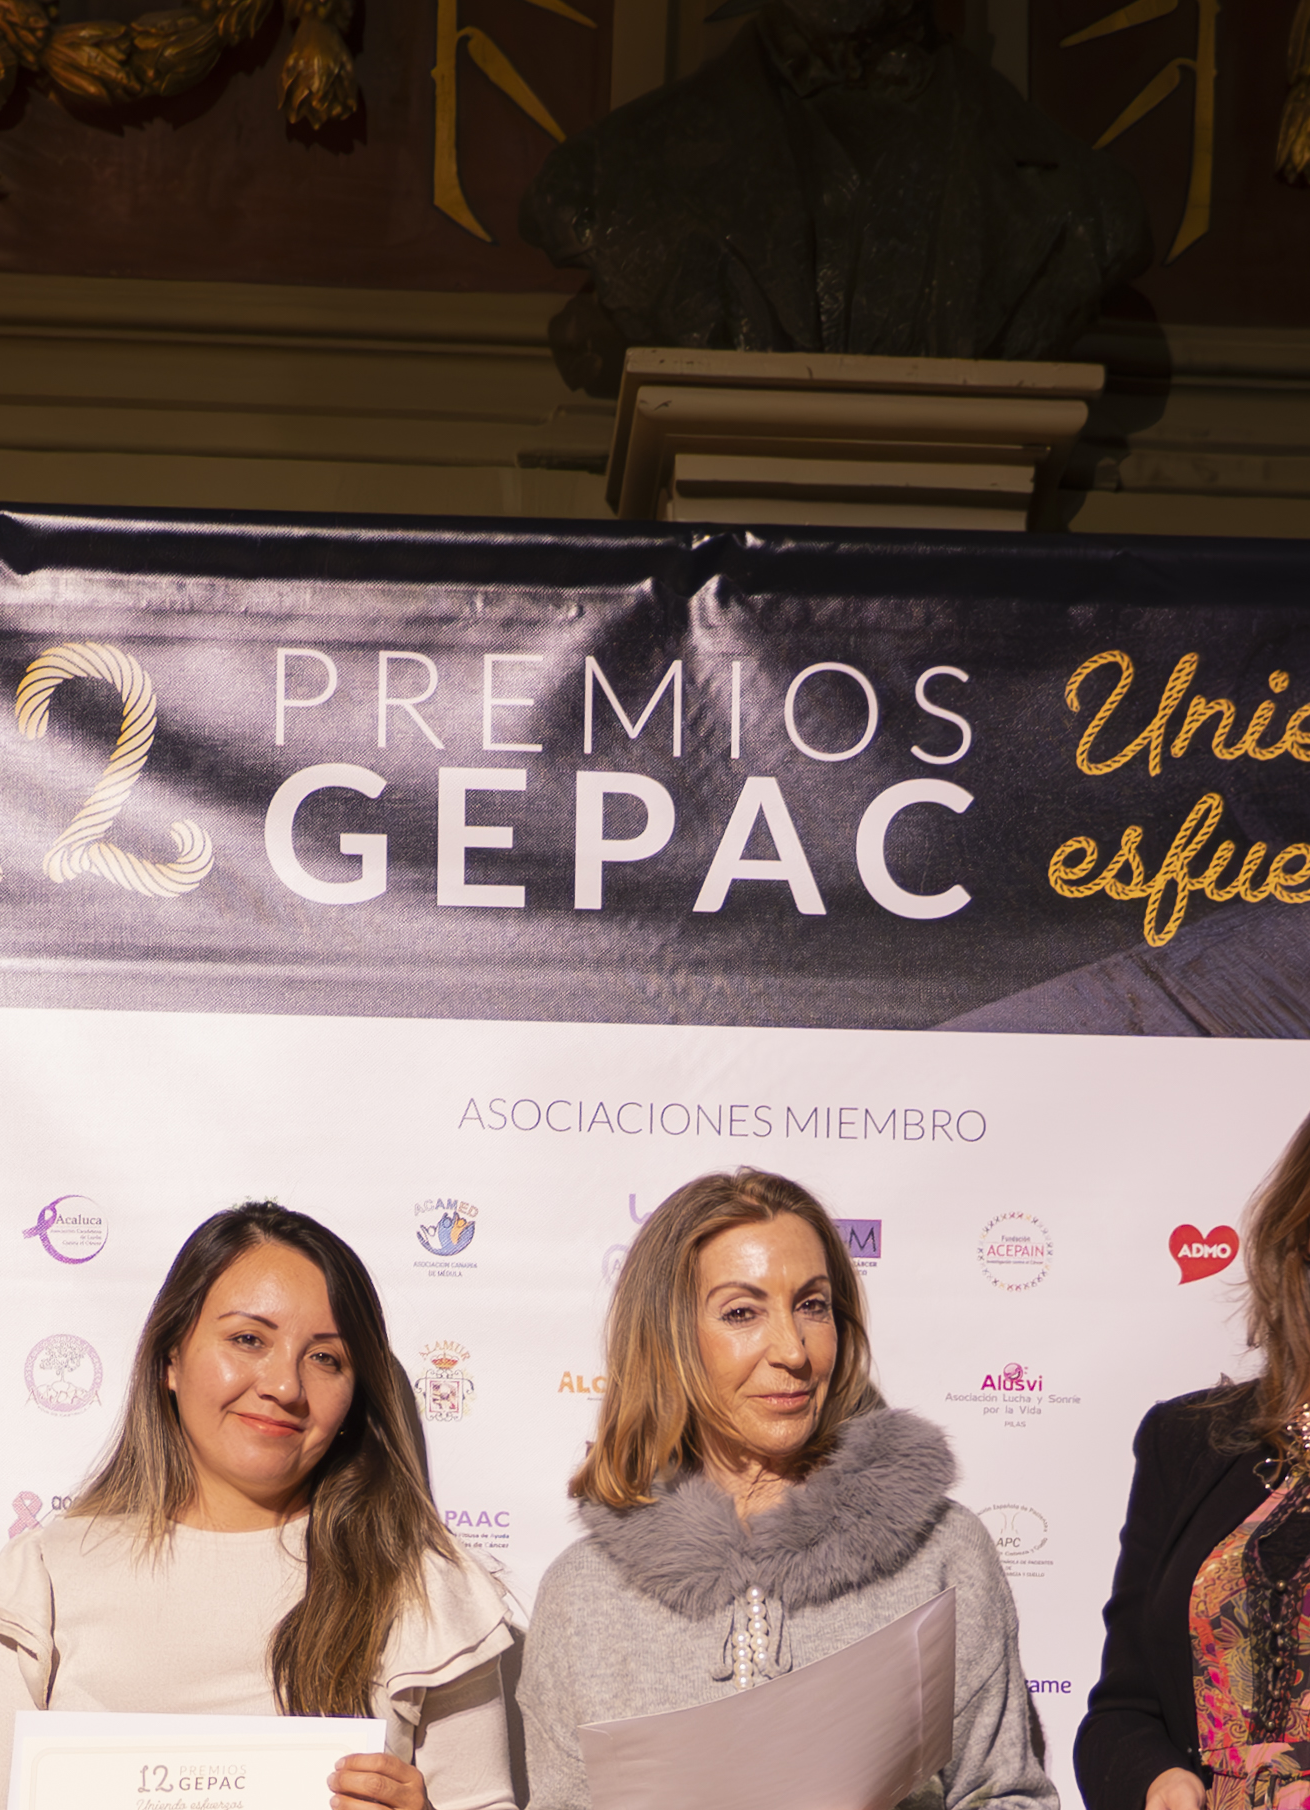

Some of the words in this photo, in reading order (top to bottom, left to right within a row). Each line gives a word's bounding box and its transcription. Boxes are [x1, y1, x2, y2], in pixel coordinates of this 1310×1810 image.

[272, 645, 977, 768] PREMIOS
[262, 762, 977, 922] GEPAC
[457, 1097, 774, 1139] ASOCIACIONES
[784, 1105, 988, 1143] MIEMBRO
[413, 1198, 479, 1218] ACAMED
[56, 1214, 102, 1225] Acaluca
[986, 1244, 1045, 1257] ACEPAIN
[1177, 1243, 1232, 1259] ADMO
[980, 1374, 1043, 1392] Alusvi
[945, 1392, 998, 1403] Asociación
[1002, 1393, 1032, 1404] Lucha
[1036, 1395, 1043, 1405] y
[983, 1406, 1000, 1416] por
[1005, 1405, 1014, 1415] la
[1019, 1405, 1042, 1415] Vida
[179, 1763, 247, 1776] PREMIOS
[136, 1763, 175, 1794] 12
[178, 1775, 247, 1792] GEPAC
